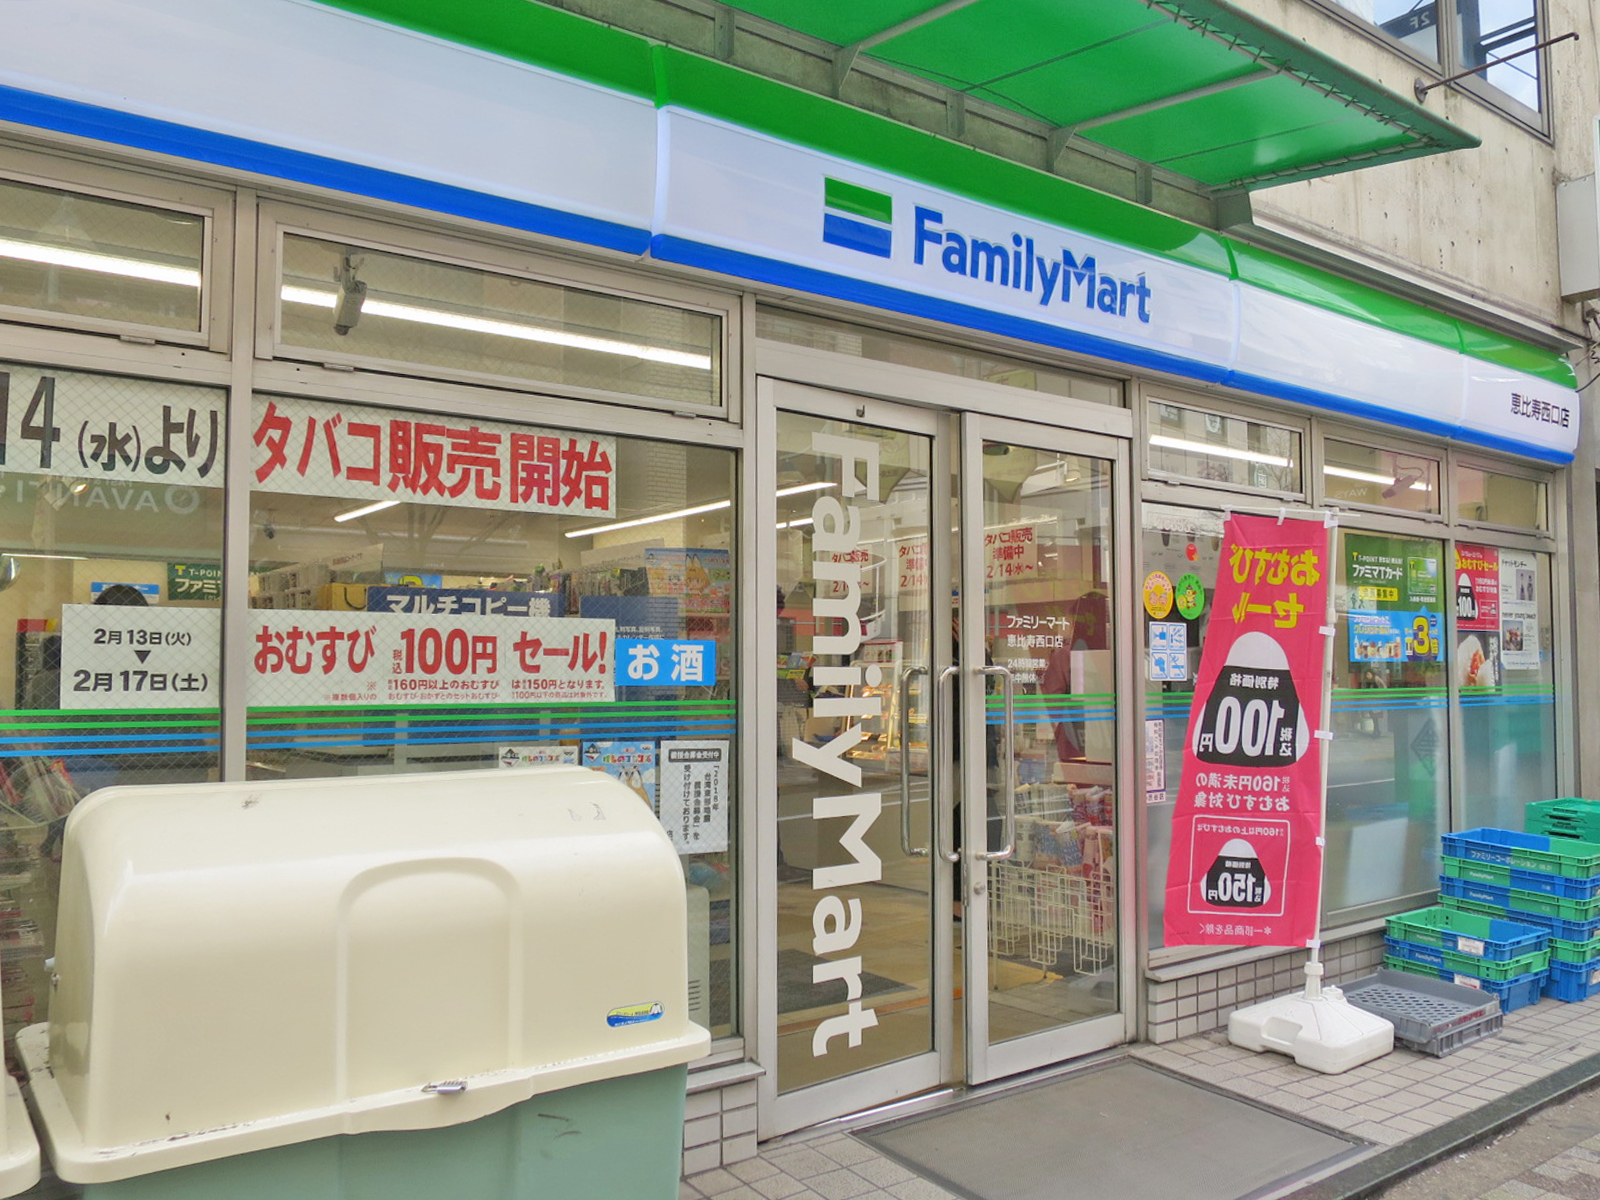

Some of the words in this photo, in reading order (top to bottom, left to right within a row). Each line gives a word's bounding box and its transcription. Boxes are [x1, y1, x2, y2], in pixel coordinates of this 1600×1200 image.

[914, 205, 1151, 323] FamilyMart
[1511, 393, 1569, 428] 恵比寿西口店
[253, 401, 612, 511] タバコ販売開始
[93, 628, 192, 646] 2月13日(火)
[1007, 615, 1070, 630] ファミリーマート
[254, 625, 377, 675] おむすび
[1007, 634, 1064, 648] 恵比寿西口店
[73, 670, 208, 692] 2月17日(土)
[792, 432, 881, 1057] FamilyMart
